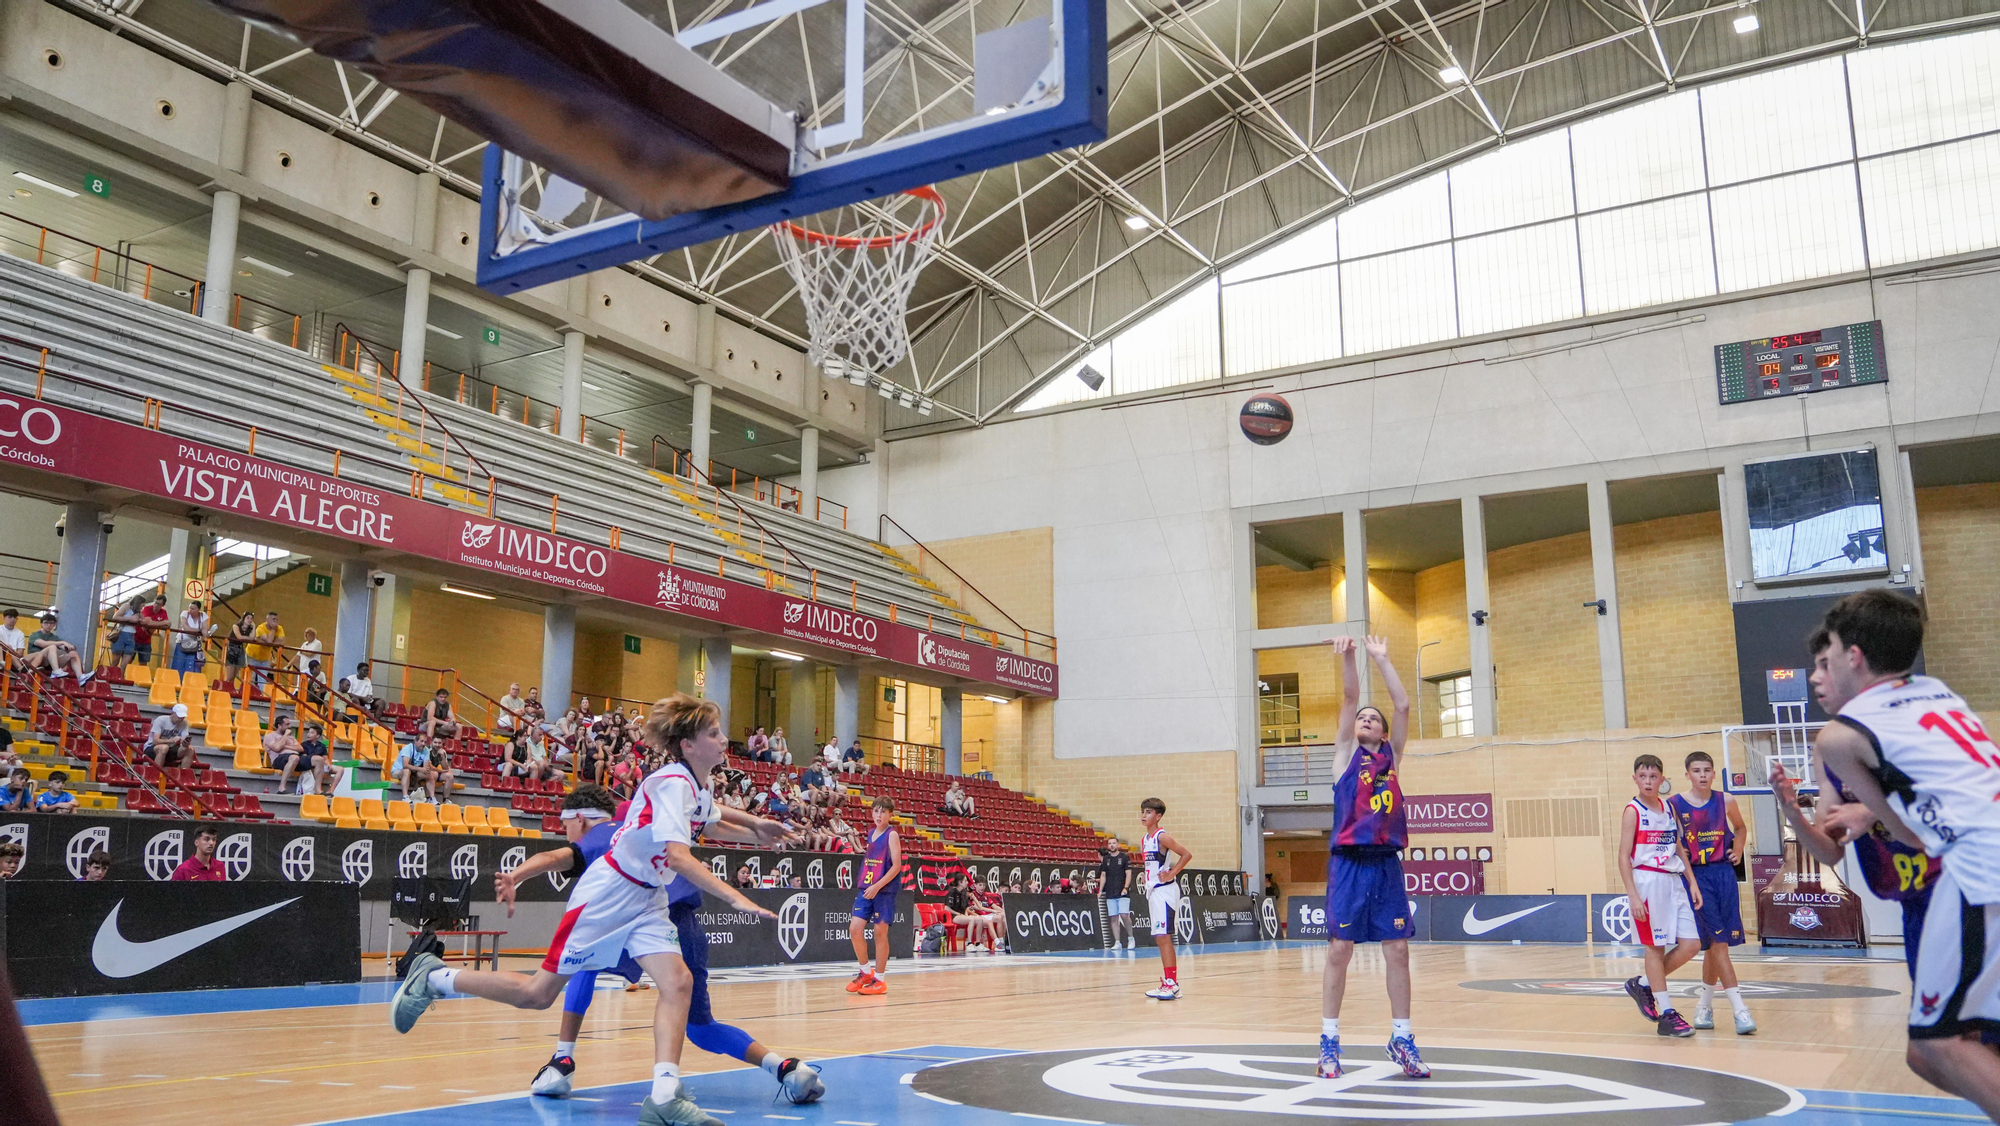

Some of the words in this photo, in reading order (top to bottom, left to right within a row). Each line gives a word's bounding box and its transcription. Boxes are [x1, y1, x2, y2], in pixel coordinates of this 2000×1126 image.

[92, 179, 103, 193] 8
[488, 330, 495, 342] 9
[1814, 343, 1839, 352] VISITANTE
[1756, 353, 1780, 362] LOCAL
[1764, 363, 1781, 376] 04
[1771, 378, 1779, 389] 5
[747, 429, 755, 440] 10
[0, 445, 55, 467] Córdoba
[178, 444, 241, 472] PALACIO
[243, 461, 316, 491] MUNICIPAL
[320, 481, 380, 507] DEPORTES
[159, 459, 259, 514] VISTA
[269, 489, 395, 544] ALEGRE
[497, 526, 607, 578] IMDECO
[461, 552, 493, 568] Instituto
[494, 560, 531, 576] Municipal
[532, 569, 542, 579] de
[543, 571, 575, 587] Deportes
[576, 578, 605, 593] Córdoba
[315, 577, 325, 592] H
[682, 578, 727, 600] AYUNTAMIENTO
[681, 594, 690, 605] DE
[806, 604, 878, 642] IMDECO
[783, 626, 804, 638] Instituto
[804, 631, 828, 645] Municipal
[828, 637, 835, 645] de
[835, 639, 857, 651] Deportes
[938, 644, 970, 661] Diputación
[938, 658, 946, 666] de
[946, 658, 970, 672] Córdoba
[1010, 657, 1053, 683] IMDECO
[1369, 789, 1393, 814] 99
[1407, 802, 1488, 820] IMDECO
[10, 826, 25, 834] FEB
[1440, 821, 1464, 829] Deportes
[1698, 847, 1715, 865] 17
[1404, 871, 1470, 892] DECO
[796, 896, 807, 904] FEB
[1788, 892, 1841, 903] IMDECO
[717, 911, 760, 925] ESPAÑOLA
[825, 912, 852, 923] FEDERA
[1015, 902, 1094, 937] endesa
[1129, 910, 1151, 928] Caixa
[1299, 904, 1327, 925] te
[825, 929, 834, 940] DE
[1300, 925, 1328, 935] despi
[705, 931, 734, 944] CESTO
[1094, 1054, 1194, 1068] FEB
